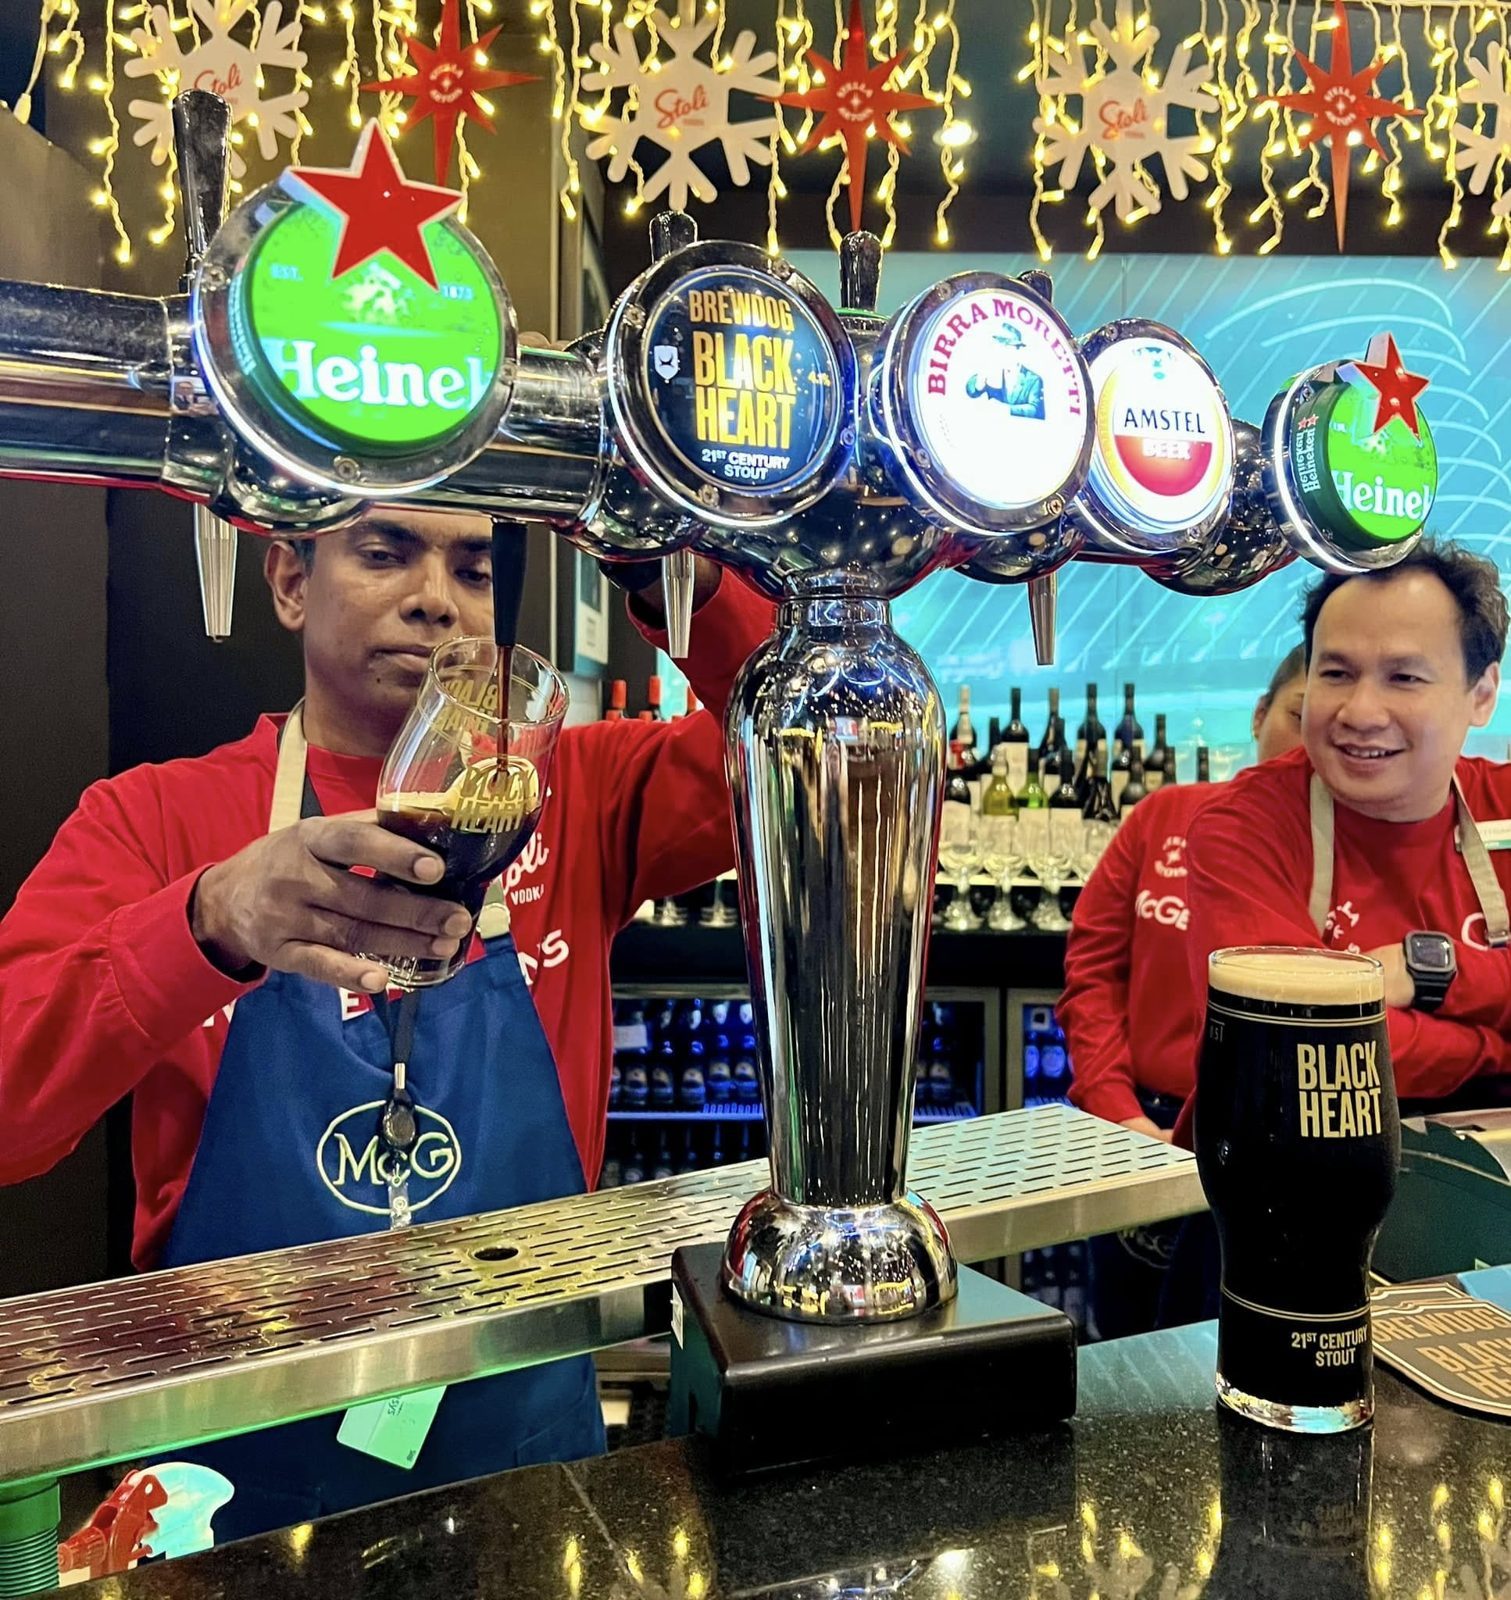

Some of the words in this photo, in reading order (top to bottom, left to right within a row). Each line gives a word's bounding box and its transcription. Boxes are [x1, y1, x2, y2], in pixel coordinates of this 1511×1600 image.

[654, 85, 707, 129] Stoli
[1099, 98, 1147, 139] Stoli
[688, 290, 795, 332] BREWDOG
[693, 331, 797, 395] BLACK
[928, 302, 989, 396] BIRRA
[696, 386, 797, 450] HEART
[1124, 407, 1206, 434] AMSTEL
[728, 453, 791, 470] CENTURY
[1142, 437, 1192, 461] BEER
[724, 464, 769, 481] STOUT
[451, 798, 529, 834] HEART
[1297, 1040, 1381, 1090] BLACK
[1299, 1087, 1381, 1138] HEART
[1291, 1331, 1317, 1349] 21ST
[1319, 1323, 1368, 1350] CENTURY
[1315, 1347, 1356, 1367] STOUT
